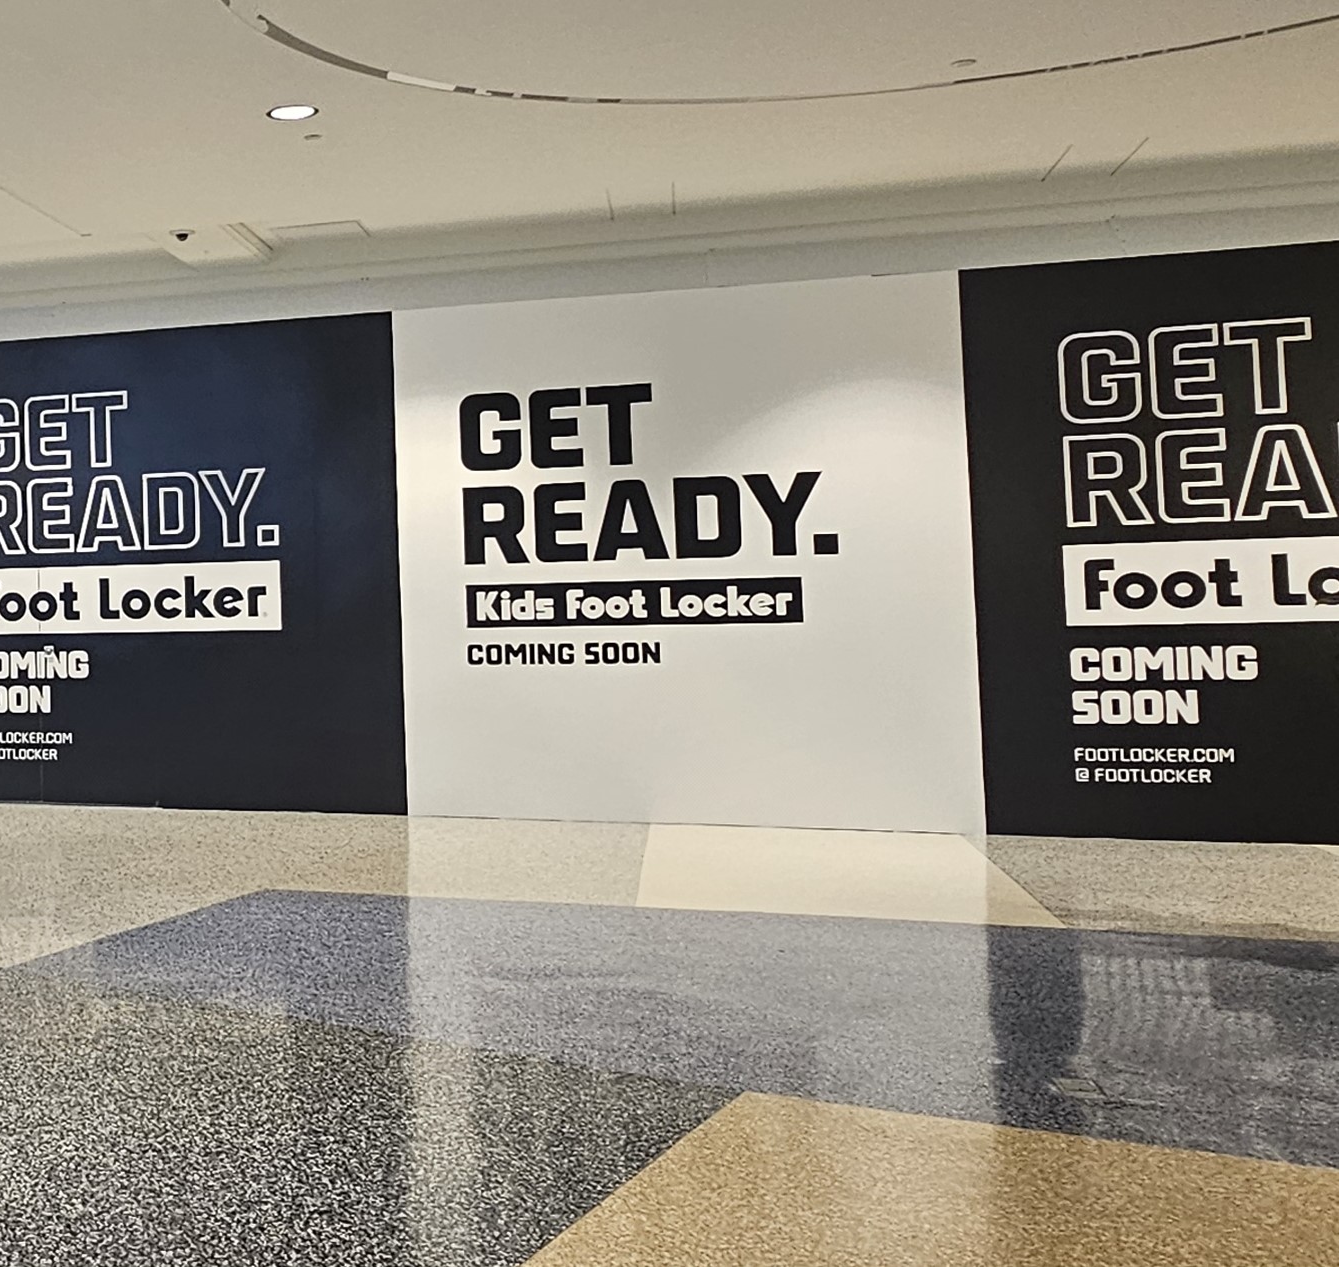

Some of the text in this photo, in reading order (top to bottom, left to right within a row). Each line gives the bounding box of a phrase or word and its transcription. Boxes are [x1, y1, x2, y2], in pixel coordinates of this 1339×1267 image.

[1058, 317, 1312, 424] GET
[459, 383, 652, 471] GET
[1062, 423, 1339, 528] REA
[462, 471, 839, 565] READY.
[99, 576, 267, 620] Locker
[476, 586, 793, 621] Kids Foot Locker
[1083, 558, 1243, 611] Foot
[467, 642, 661, 665] COMING SOON
[1069, 646, 1259, 682] COMING
[1072, 689, 1200, 725] SOON
[1074, 747, 1235, 763] FOOTLOCKER.COM
[1075, 767, 1212, 783] @ FOOTLOCKER
